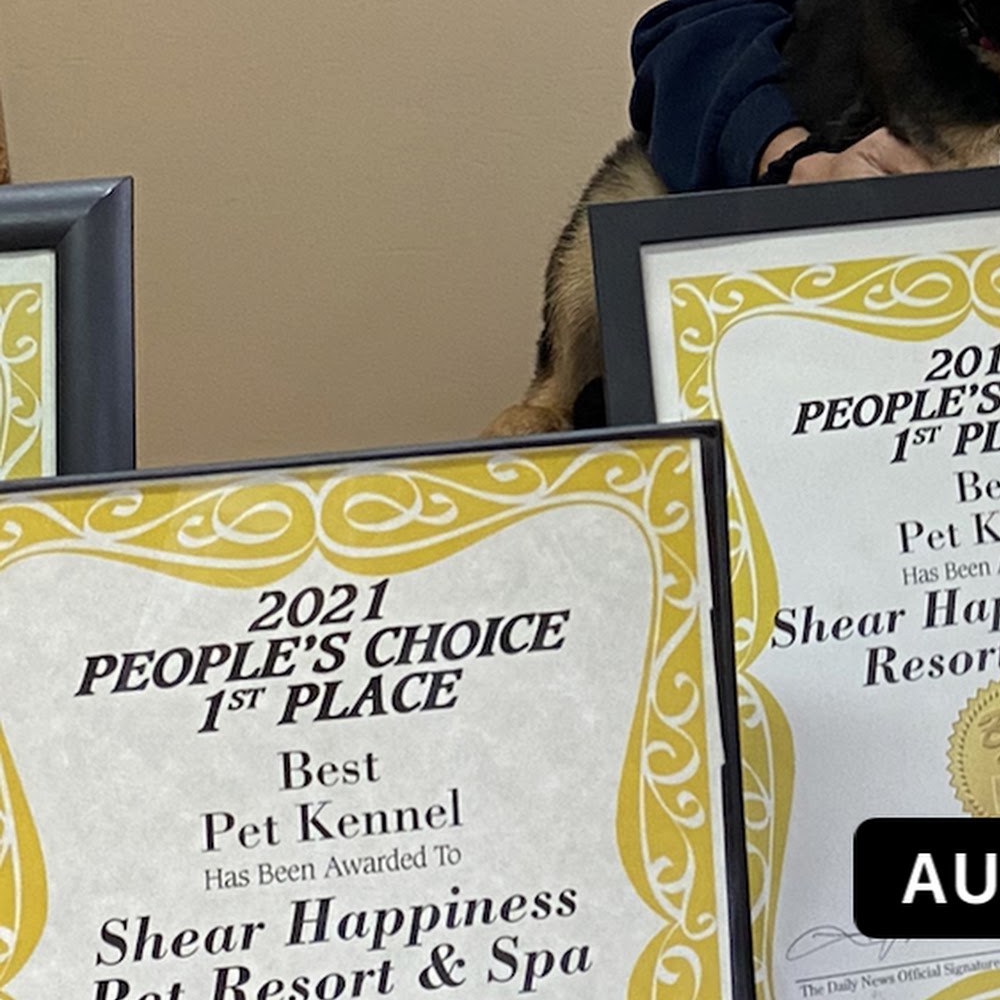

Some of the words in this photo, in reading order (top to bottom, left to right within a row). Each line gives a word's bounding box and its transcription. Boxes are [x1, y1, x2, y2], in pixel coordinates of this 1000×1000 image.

[891, 425, 942, 464] 1ST
[897, 520, 959, 555] Pet
[902, 565, 940, 586] Has
[945, 560, 992, 581] Been
[248, 578, 390, 632] 2021
[770, 604, 906, 650] Shear
[74, 631, 350, 697] PEOPLE'S
[365, 609, 570, 668] CHOICE
[198, 687, 266, 734] 1ST
[278, 668, 464, 727] PLACE
[278, 749, 381, 792] Best
[201, 811, 280, 853] Pet
[296, 789, 464, 844] Kennel
[205, 867, 250, 891] Has
[258, 861, 316, 885] Been
[325, 847, 428, 879] Awarded
[434, 844, 462, 867] To
[95, 916, 265, 967] Shear
[284, 886, 579, 952] Happiness
[212, 960, 395, 1000] Resort
[418, 941, 467, 993] &
[486, 933, 594, 994] Spa
[801, 983, 825, 998] The
[827, 977, 858, 994] Daily
[861, 972, 895, 989] News
[897, 963, 942, 983] Official
[944, 958, 1000, 978] Signature
